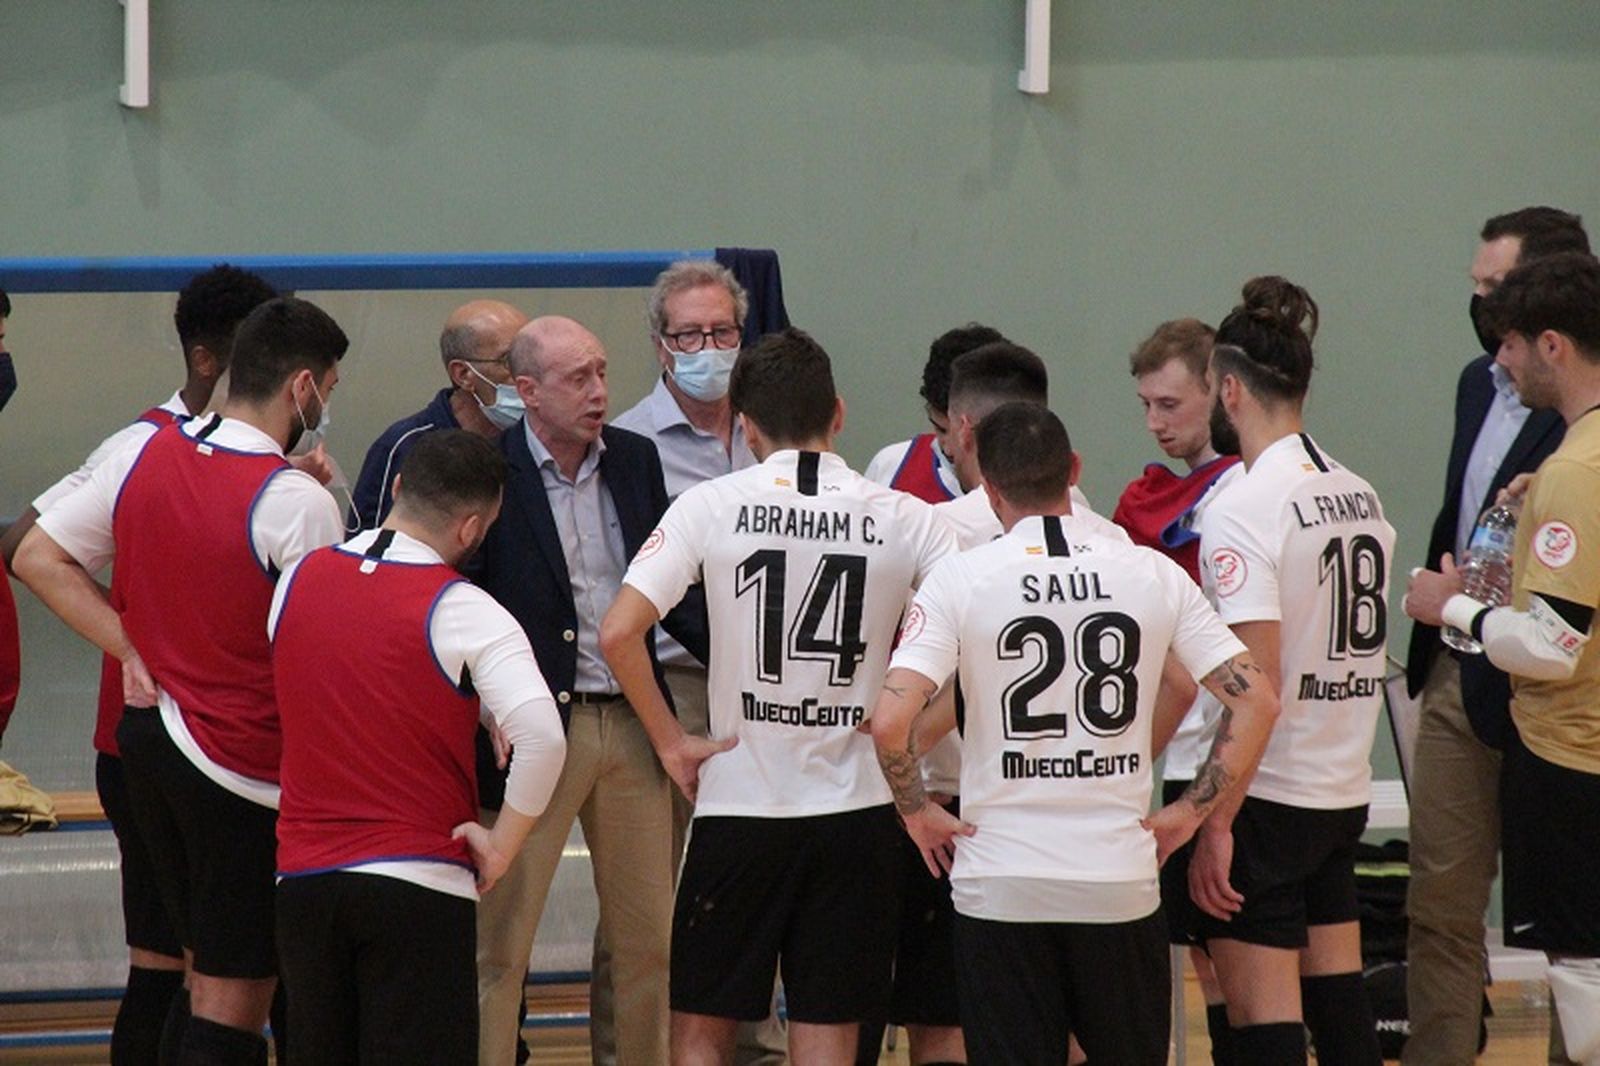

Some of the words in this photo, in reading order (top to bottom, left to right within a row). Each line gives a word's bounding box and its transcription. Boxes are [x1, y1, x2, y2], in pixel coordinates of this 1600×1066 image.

[735, 505, 850, 541] ABRAHAM
[862, 515, 883, 545] C.
[1021, 567, 1112, 603] SAÚL
[736, 549, 867, 686] 14
[1319, 534, 1387, 661] 18
[998, 612, 1141, 741] 28
